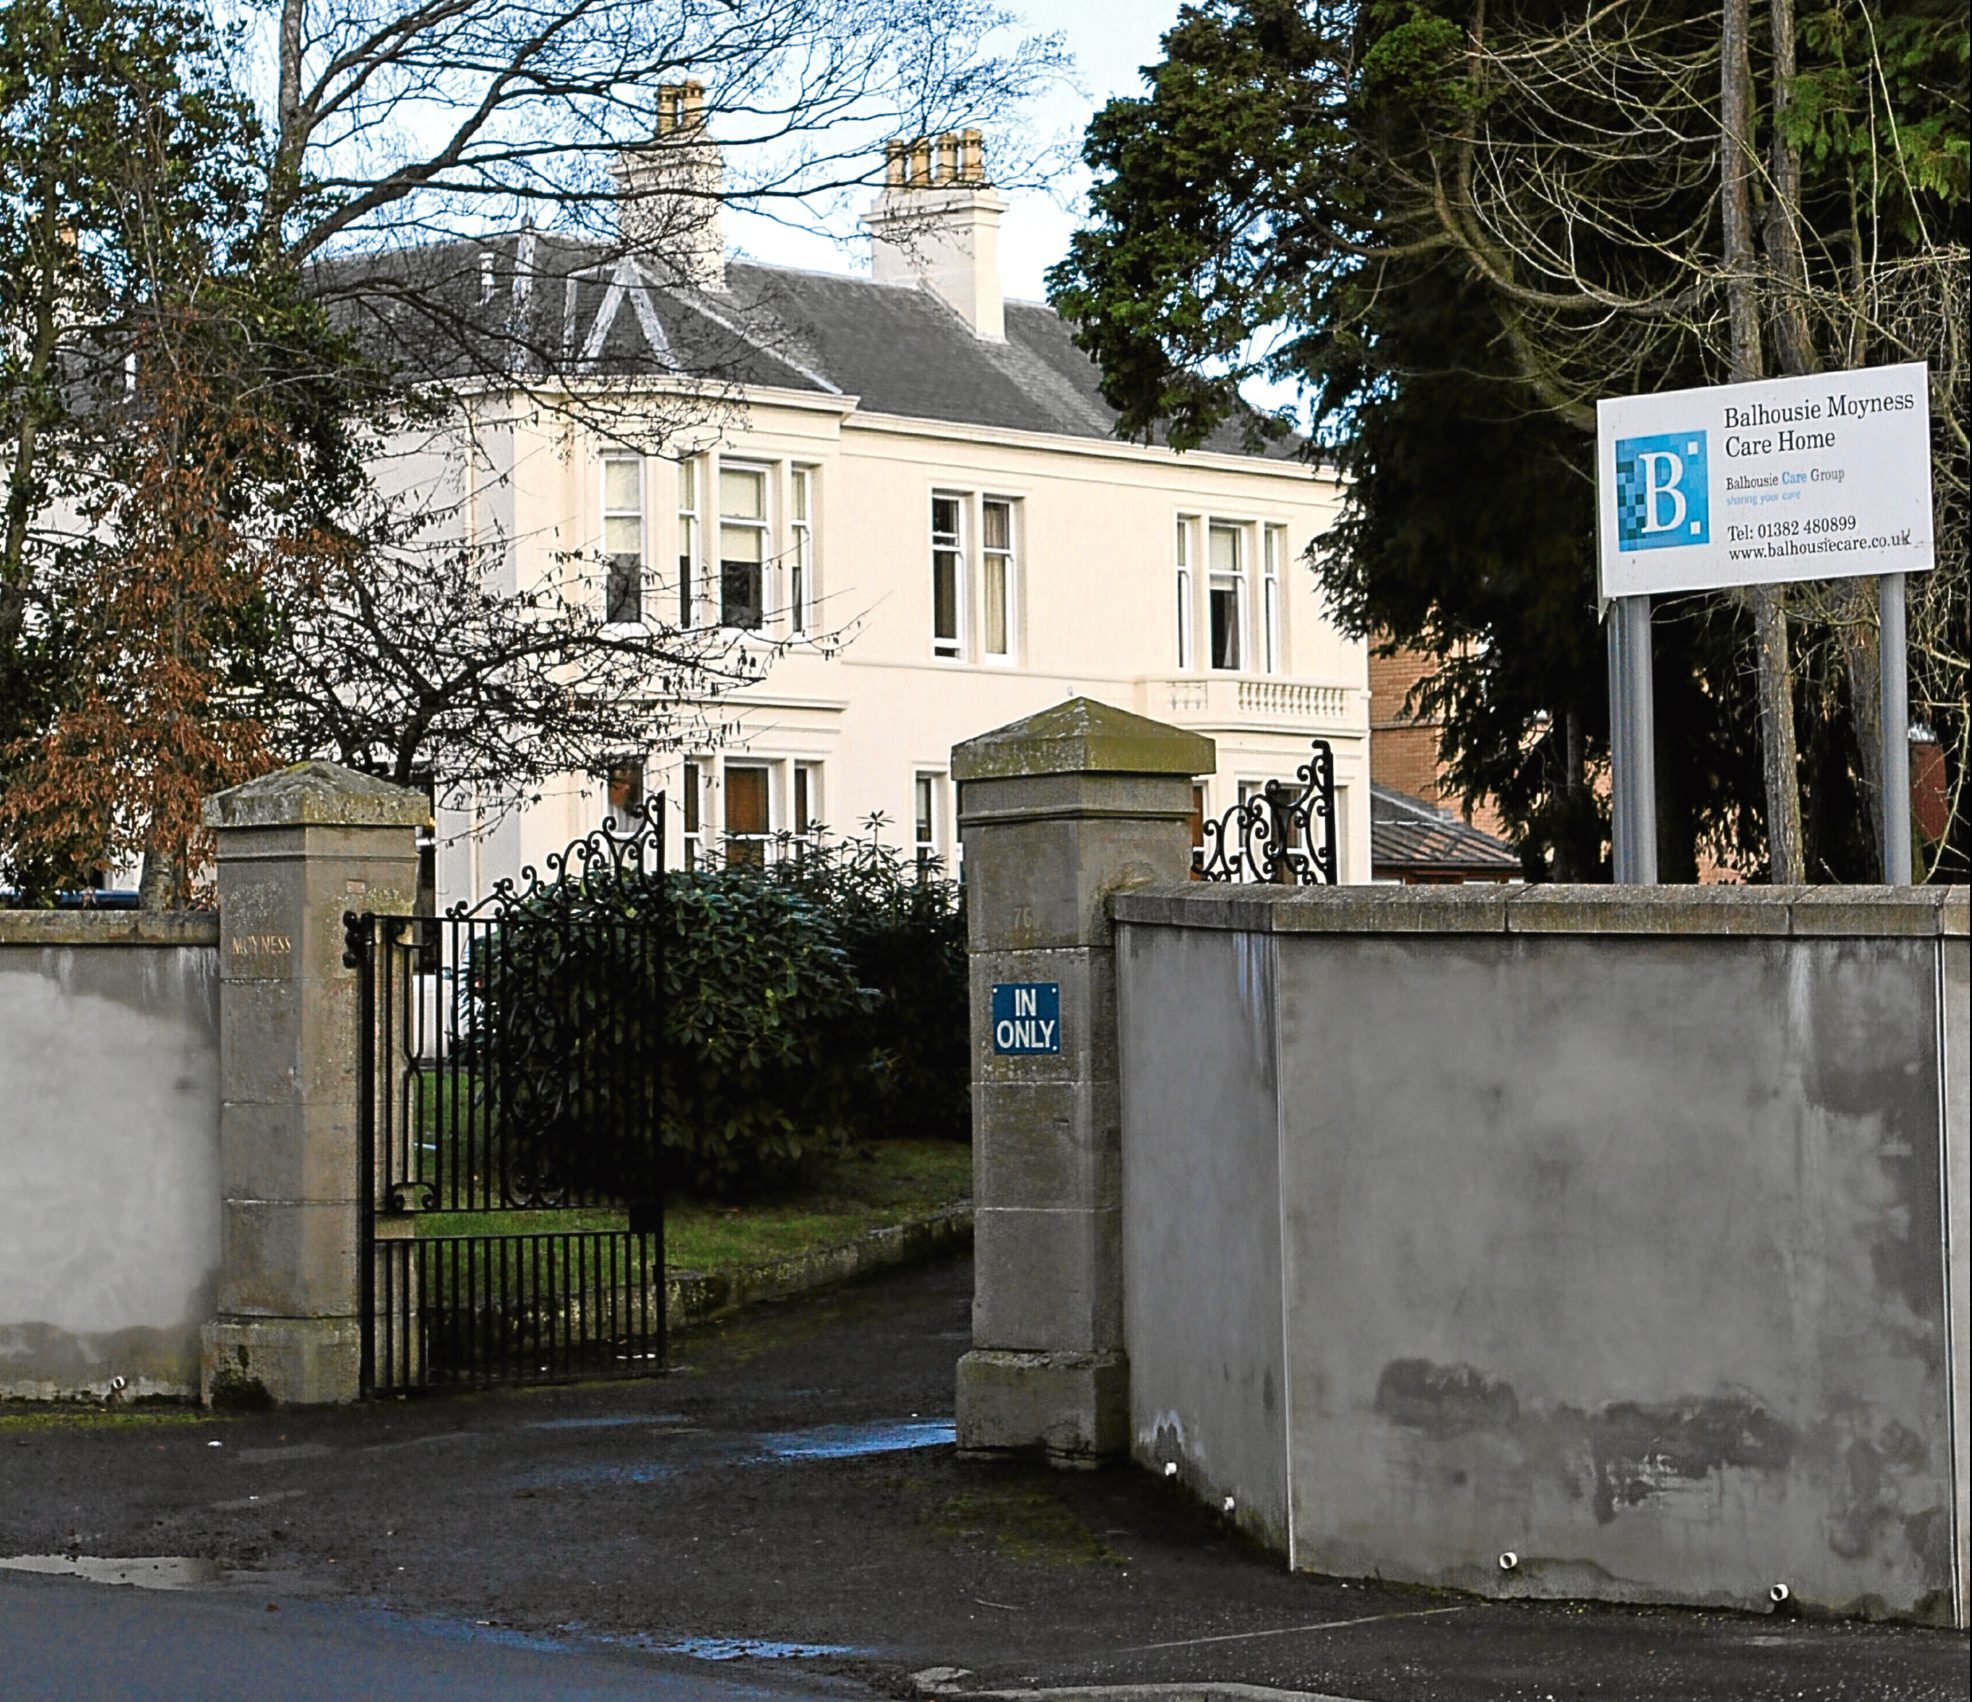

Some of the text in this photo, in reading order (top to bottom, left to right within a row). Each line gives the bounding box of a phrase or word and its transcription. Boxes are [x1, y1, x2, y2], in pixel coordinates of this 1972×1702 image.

[1724, 394, 1915, 429] Balhousie Moyness
[1725, 430, 1836, 458] Care Home
[1726, 468, 1845, 491] Balhousie Care Group
[1726, 490, 1801, 506] sharing your care
[1727, 515, 1857, 542] Tel: 01382 480899
[1728, 529, 1911, 561] www.balhousiecare.co.uk
[1013, 906, 1033, 928] 76
[1014, 988, 1037, 1017] IN
[996, 1019, 1056, 1049] ONLY
